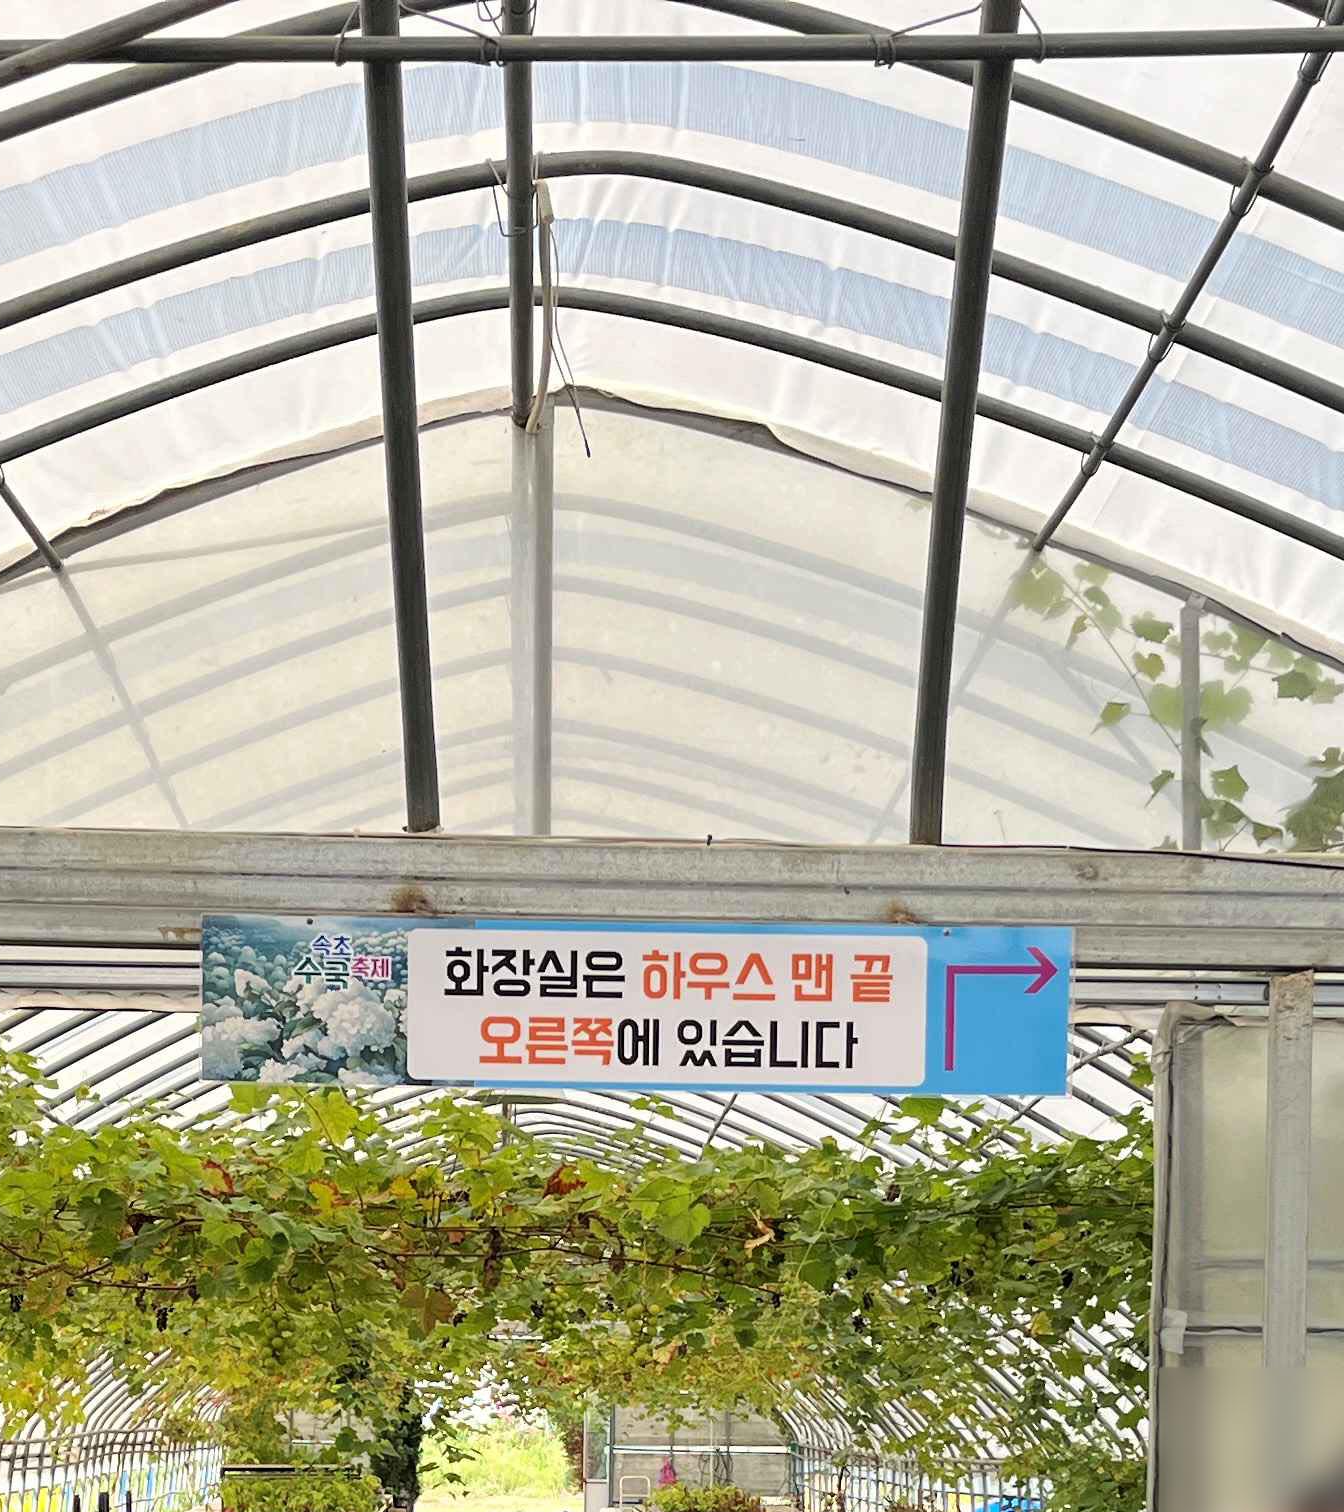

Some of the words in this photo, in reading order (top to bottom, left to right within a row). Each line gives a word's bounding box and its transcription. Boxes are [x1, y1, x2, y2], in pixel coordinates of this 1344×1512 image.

[312, 935, 352, 956] 속초
[444, 946, 626, 999] 화장실은
[642, 949, 776, 1001] 하우스
[791, 953, 834, 1002] 맨
[850, 954, 894, 1003] 끝
[479, 1015, 660, 1067] 오른쪽에
[676, 1018, 859, 1069] 있습니다
